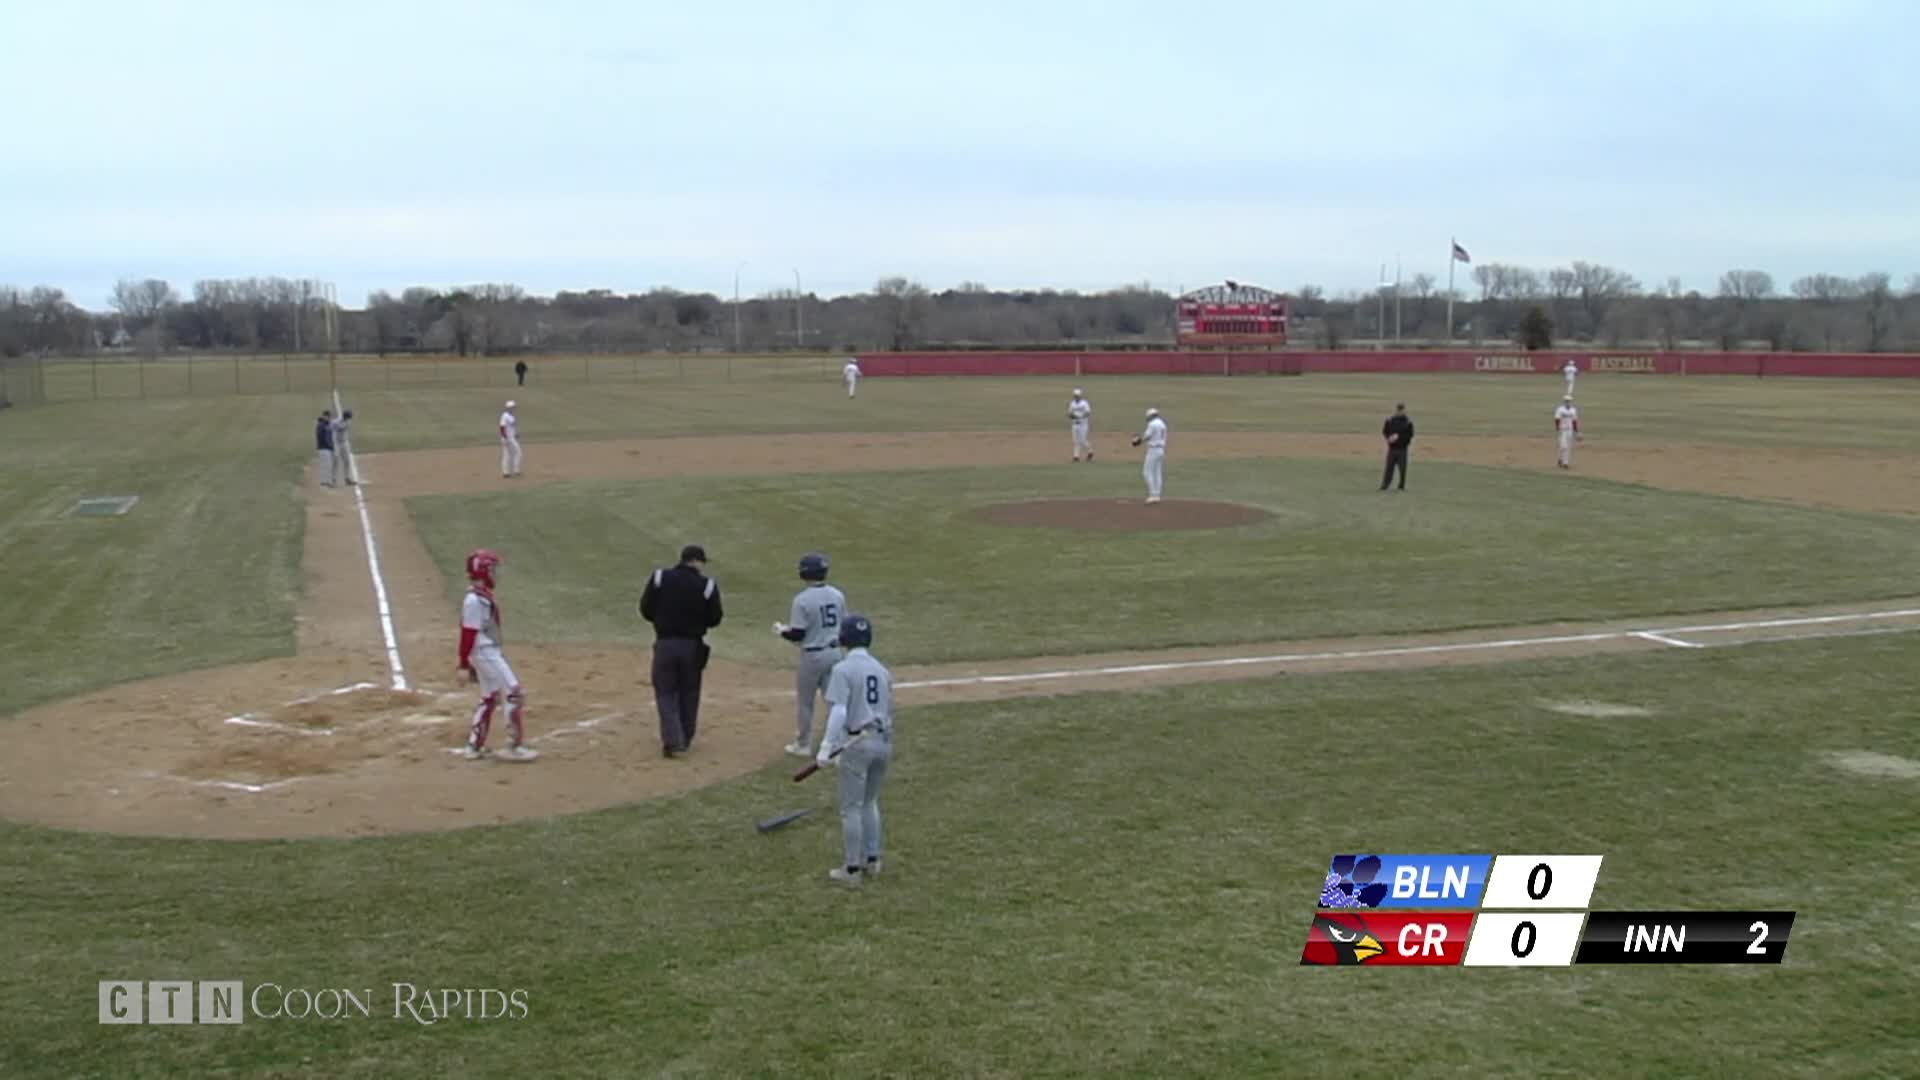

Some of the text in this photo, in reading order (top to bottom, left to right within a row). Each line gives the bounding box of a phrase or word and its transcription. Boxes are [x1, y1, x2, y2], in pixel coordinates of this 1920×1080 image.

[1474, 355, 1536, 371] CARDINAL
[819, 603, 838, 628] 15
[866, 675, 879, 705] 8
